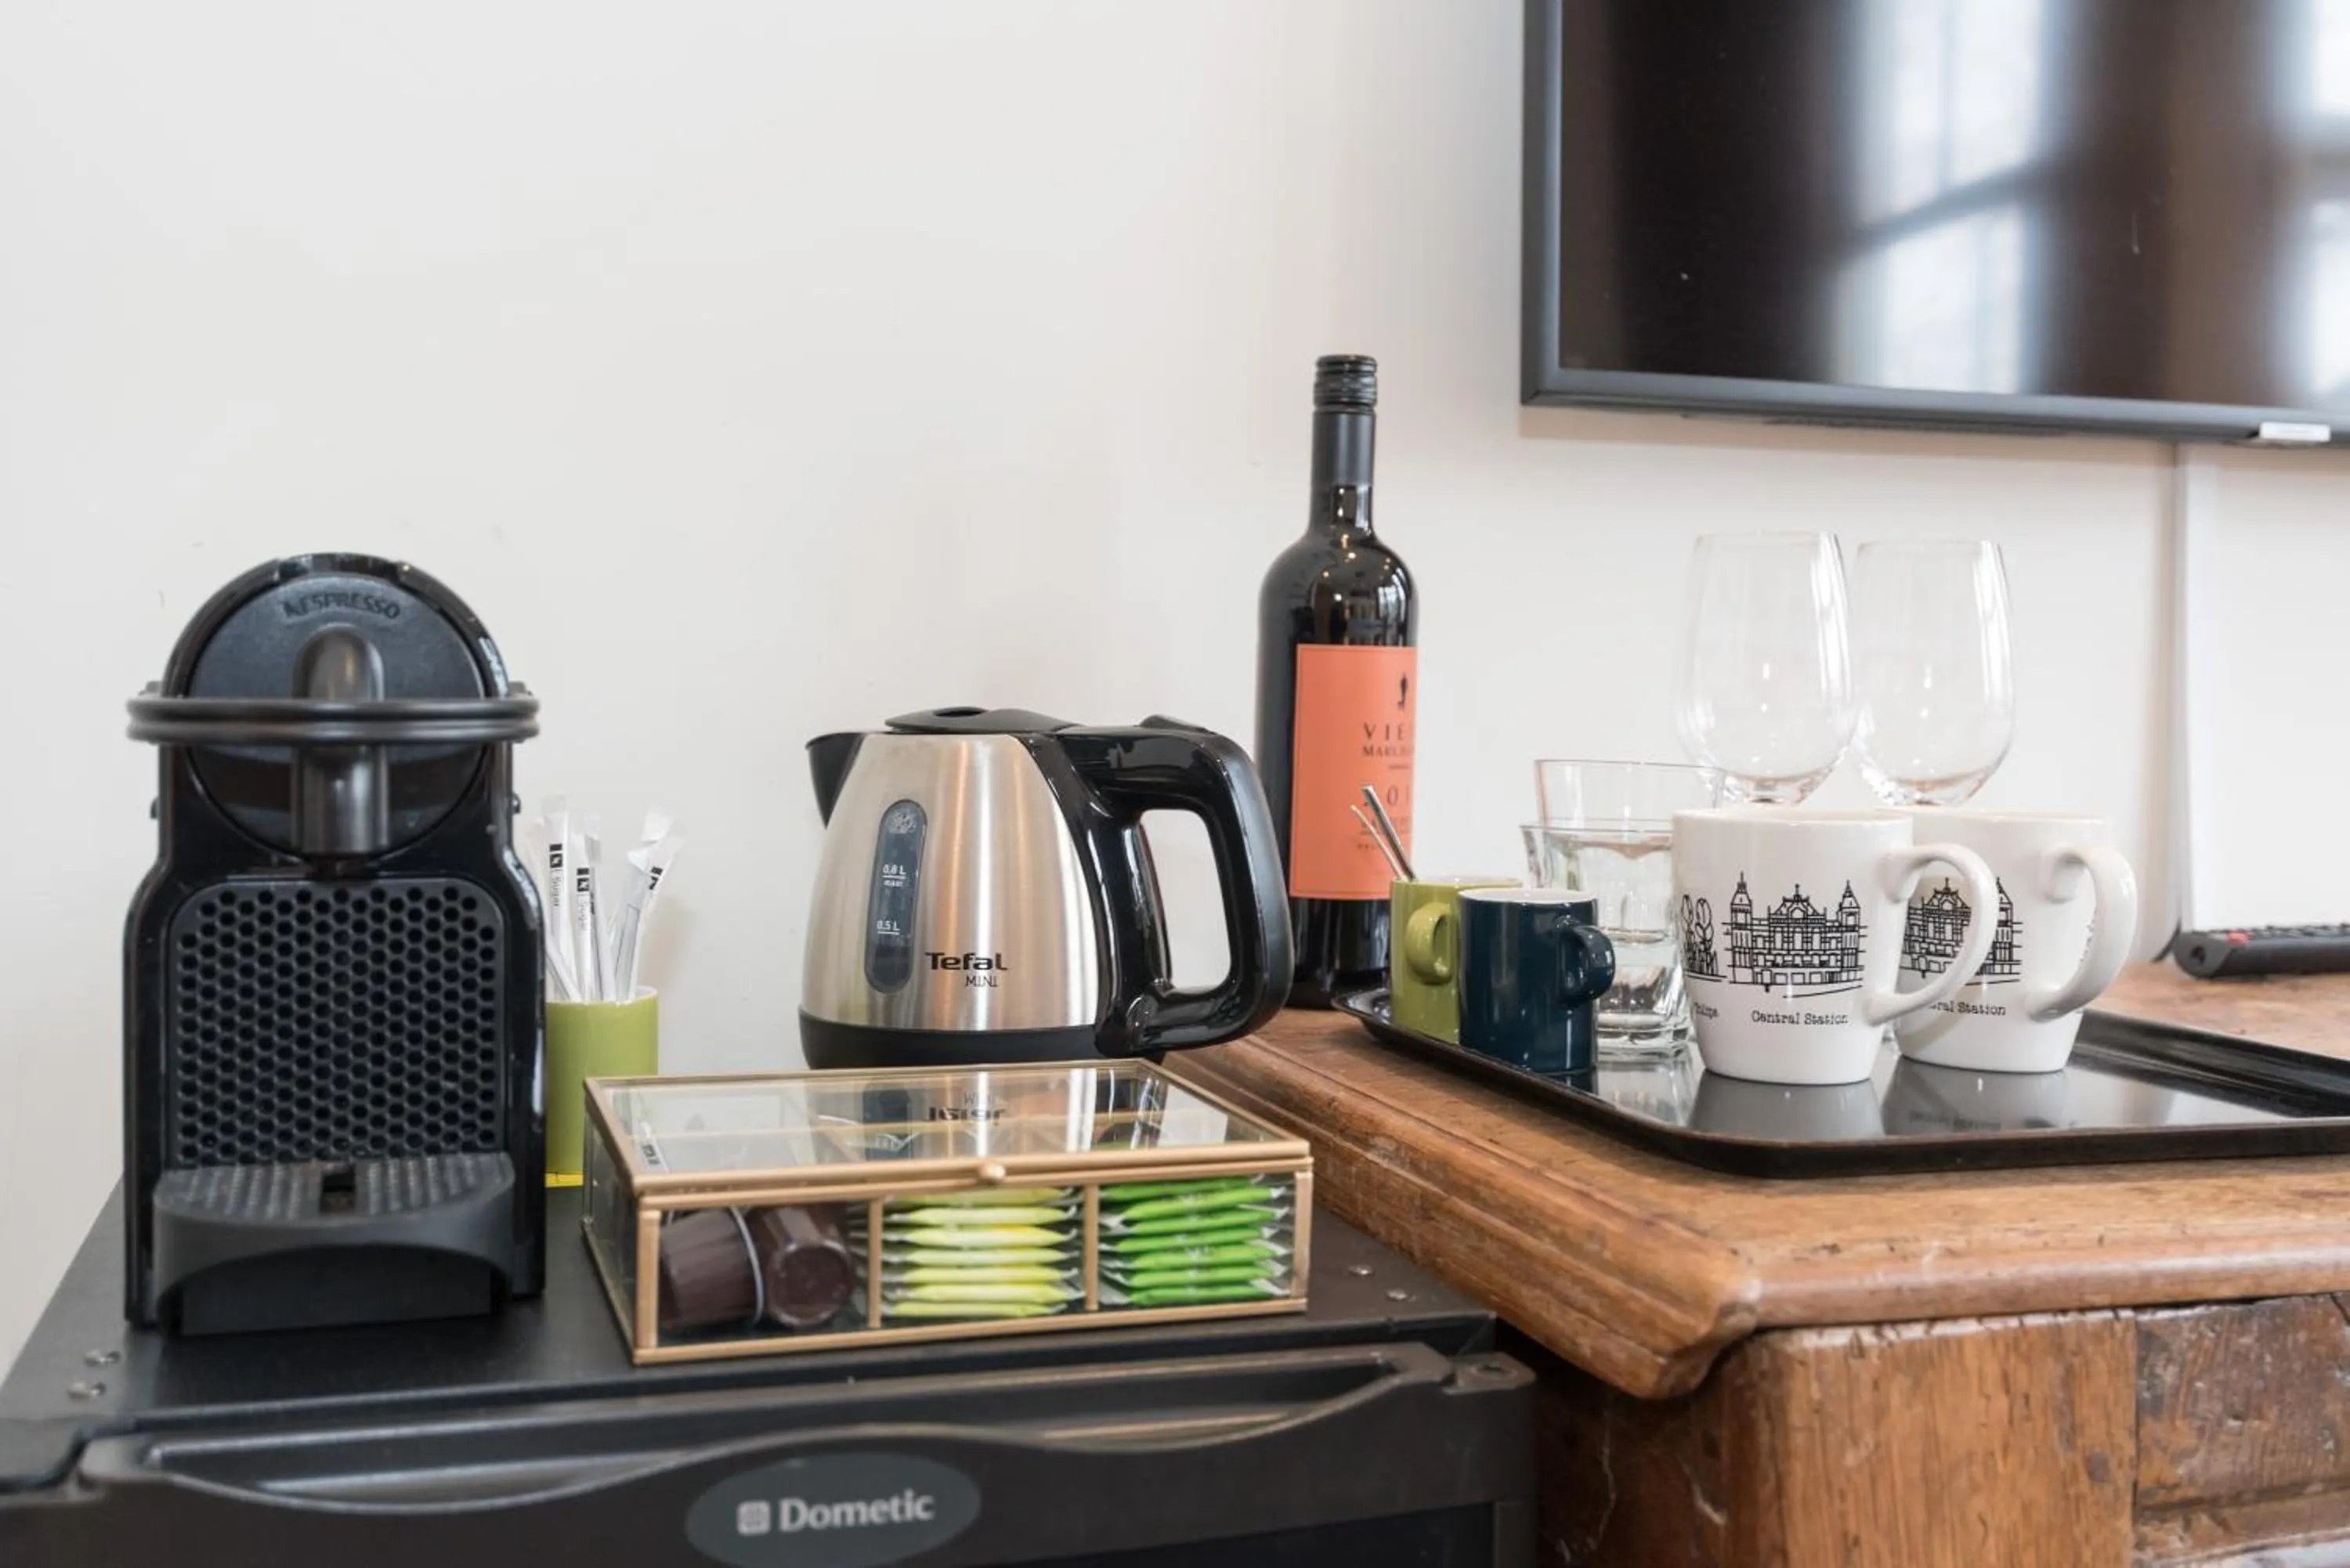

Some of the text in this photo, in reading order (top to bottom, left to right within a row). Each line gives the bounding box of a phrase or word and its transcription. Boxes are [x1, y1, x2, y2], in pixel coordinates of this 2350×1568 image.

[280, 591, 401, 620] NESPRESSO
[925, 952, 1009, 971] Tefal
[965, 975, 999, 988] MINI
[1752, 1009, 1849, 1025] Central Station
[1957, 1001, 2007, 1016] Station
[779, 1488, 936, 1533] Dometic
